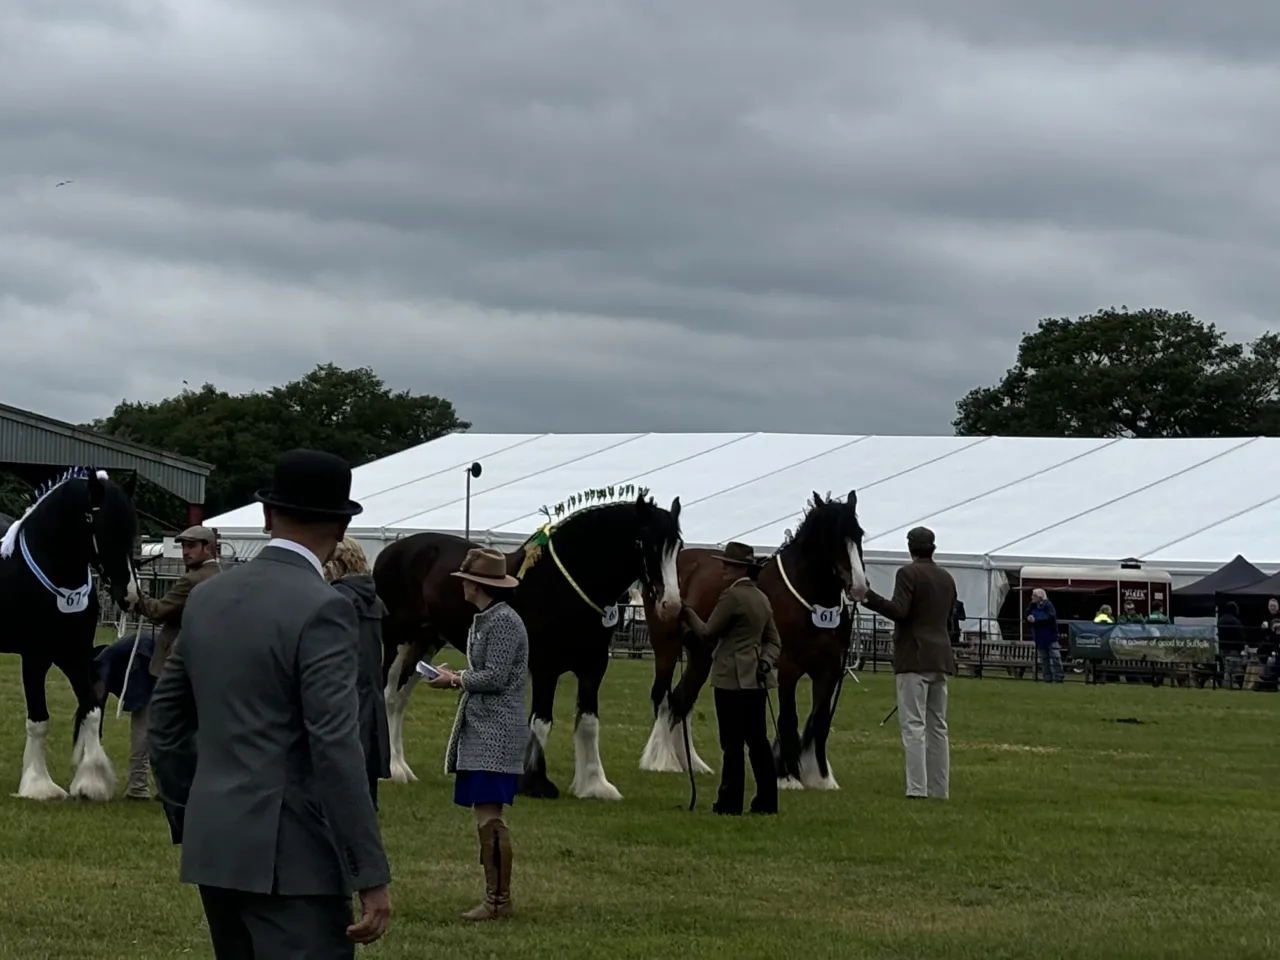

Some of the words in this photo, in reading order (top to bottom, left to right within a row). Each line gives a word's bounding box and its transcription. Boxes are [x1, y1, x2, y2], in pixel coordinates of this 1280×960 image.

[66, 591, 82, 606] 67
[820, 610, 833, 622] 61
[1116, 637, 1127, 646] The
[1128, 639, 1148, 647] power
[1149, 638, 1157, 646] of
[1158, 638, 1175, 648] good
[1176, 639, 1185, 647] for
[1186, 639, 1210, 648] Suffolk
